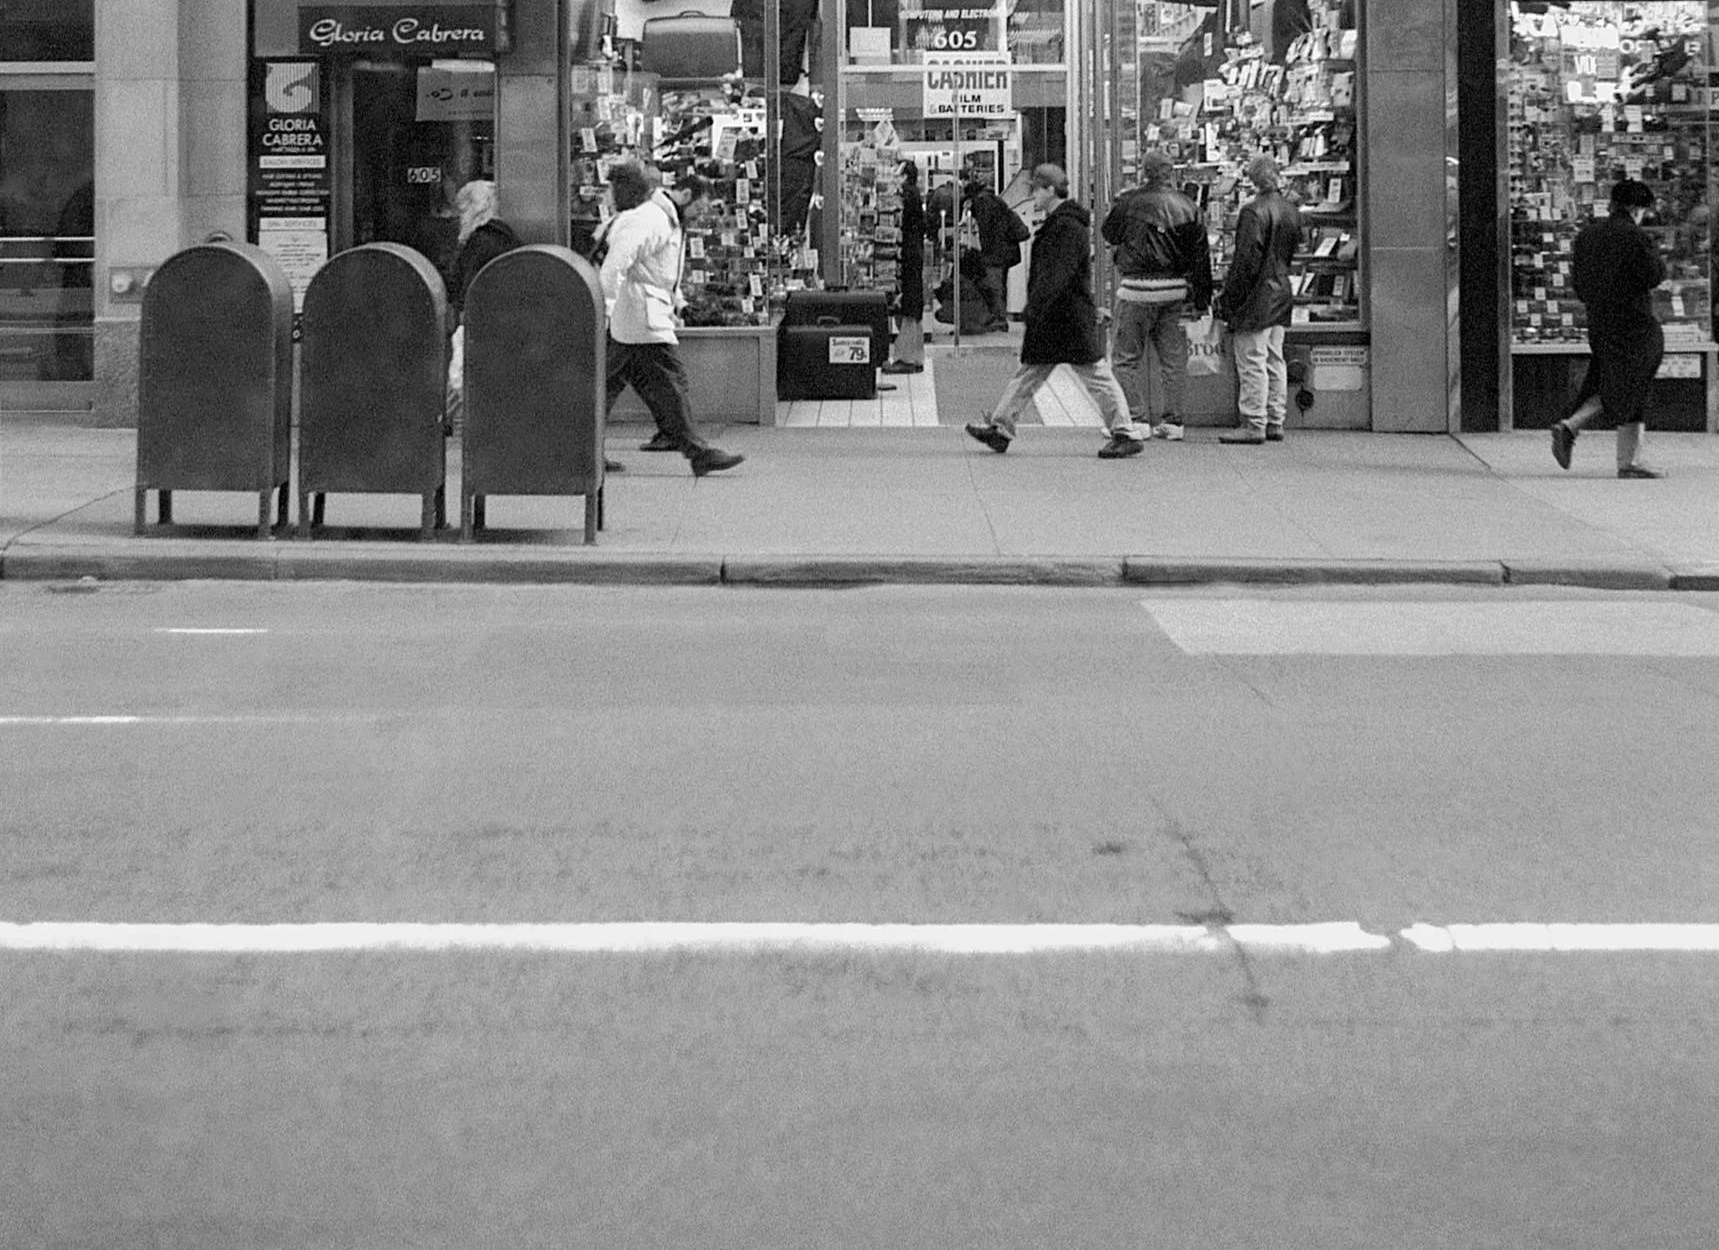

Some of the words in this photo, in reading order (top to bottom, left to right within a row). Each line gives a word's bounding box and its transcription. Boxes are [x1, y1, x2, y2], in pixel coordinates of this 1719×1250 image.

[309, 18, 385, 47] Gloria
[391, 17, 486, 45] Cabrera
[933, 30, 977, 49] 605
[268, 118, 317, 132] GLORIA
[262, 133, 324, 147] CABRERA
[408, 168, 440, 182] 605
